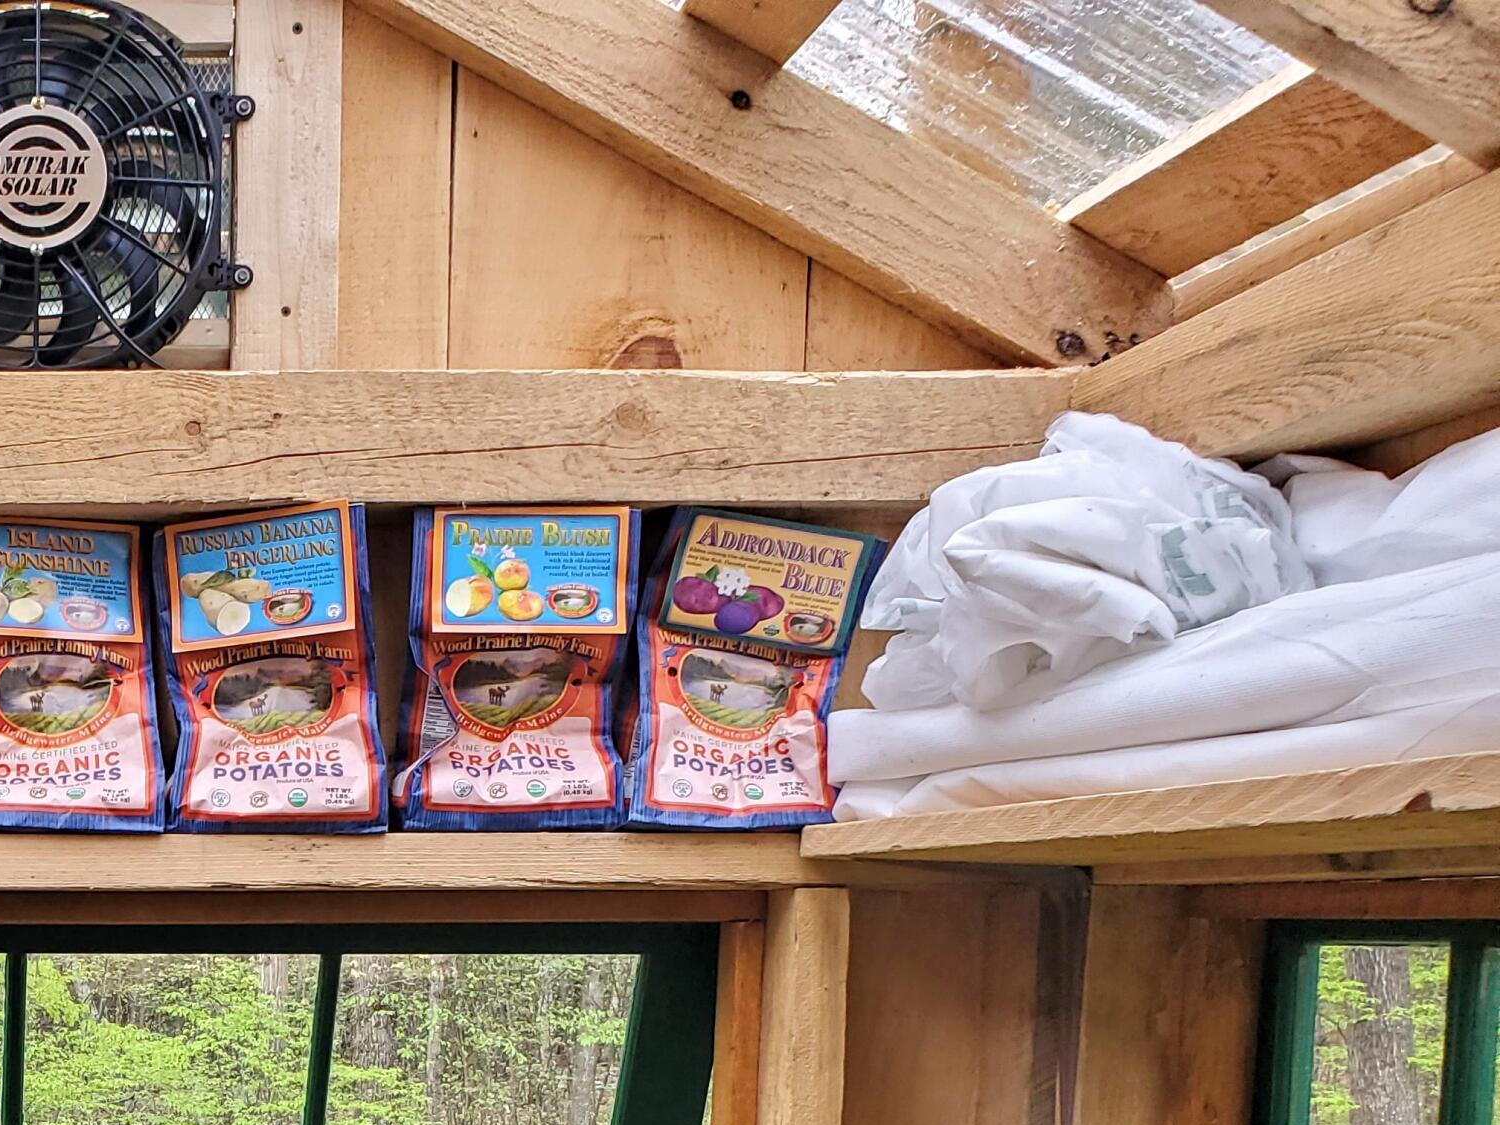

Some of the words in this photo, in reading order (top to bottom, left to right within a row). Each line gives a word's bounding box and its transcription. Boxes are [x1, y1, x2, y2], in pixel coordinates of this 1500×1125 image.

[7, 527, 96, 555] ISLAND
[258, 516, 338, 543] BANANA
[432, 637, 472, 656] Wood
[476, 634, 523, 650] Prairie
[525, 634, 570, 652] Family
[570, 637, 603, 659] Farm
[657, 630, 692, 646] Wood
[694, 631, 737, 650] Prairie
[11, 640, 54, 656] Prairie
[57, 639, 100, 662] Family
[100, 645, 134, 671] Farm
[186, 654, 224, 676] Wood
[227, 643, 270, 664] Prairie
[273, 640, 315, 661] Family
[315, 642, 353, 660] Farm
[79, 711, 112, 737] Maine
[526, 707, 564, 728] Maine
[31, 745, 87, 760] CERTIFIED
[91, 741, 118, 752] SEED
[540, 737, 565, 746] SEED
[215, 746, 340, 766] ORGANIC
[449, 742, 570, 767] ORGANIC
[673, 754, 795, 777] POTATOES
[214, 762, 344, 781] POTATOES
[452, 756, 575, 778] POTATOES
